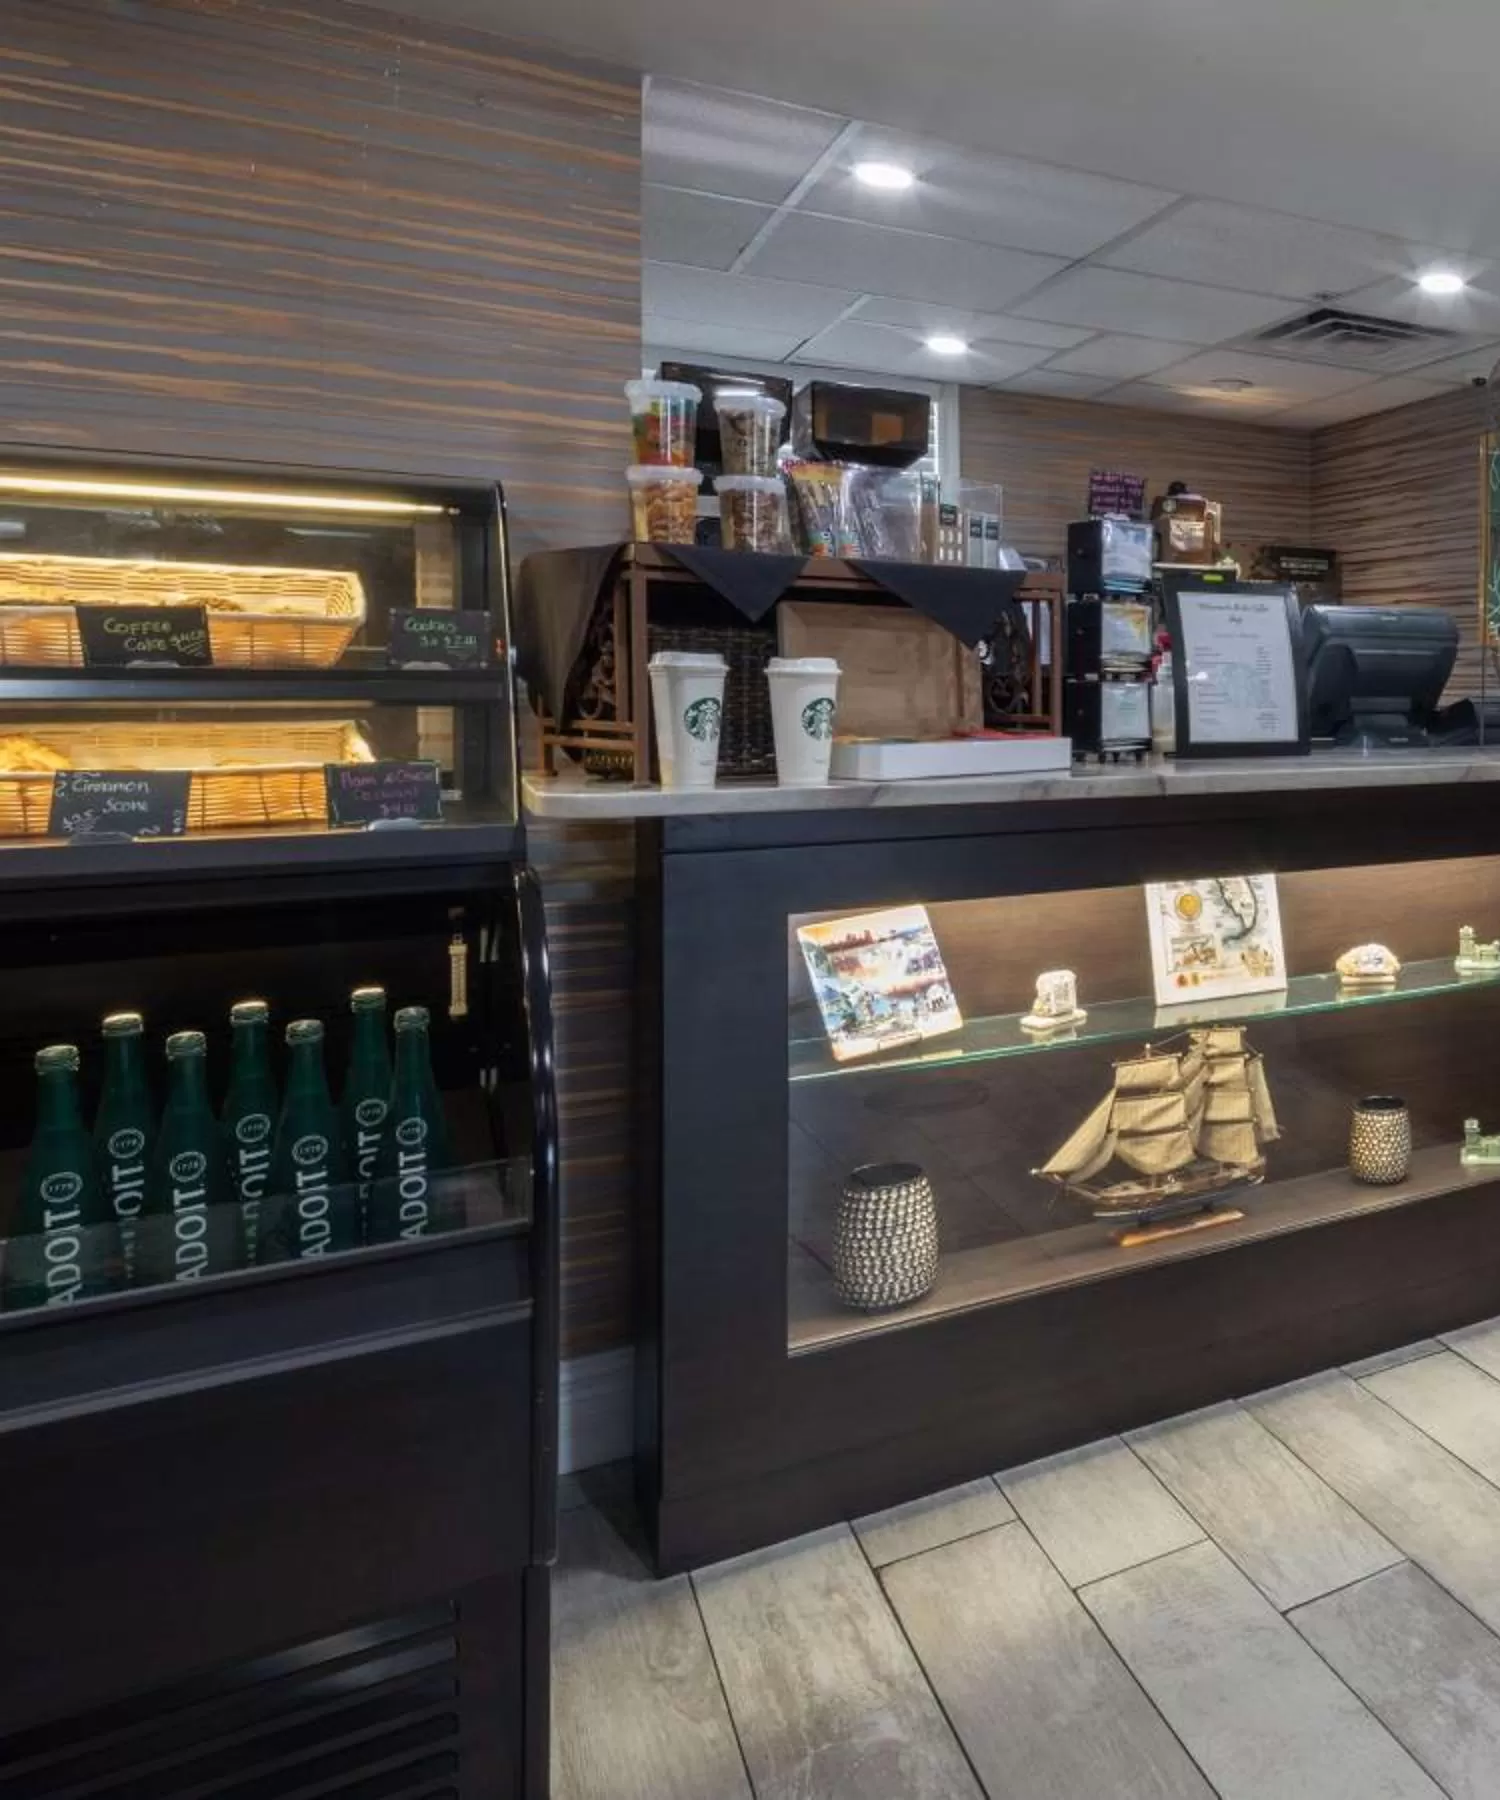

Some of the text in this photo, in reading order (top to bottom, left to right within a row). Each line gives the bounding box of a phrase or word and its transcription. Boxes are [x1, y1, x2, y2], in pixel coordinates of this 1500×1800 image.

[173, 1187, 208, 1281] ADOIT
[296, 1168, 332, 1258] ADOIT
[398, 1150, 429, 1241] ADOIT
[44, 1205, 82, 1307] ADOIT
